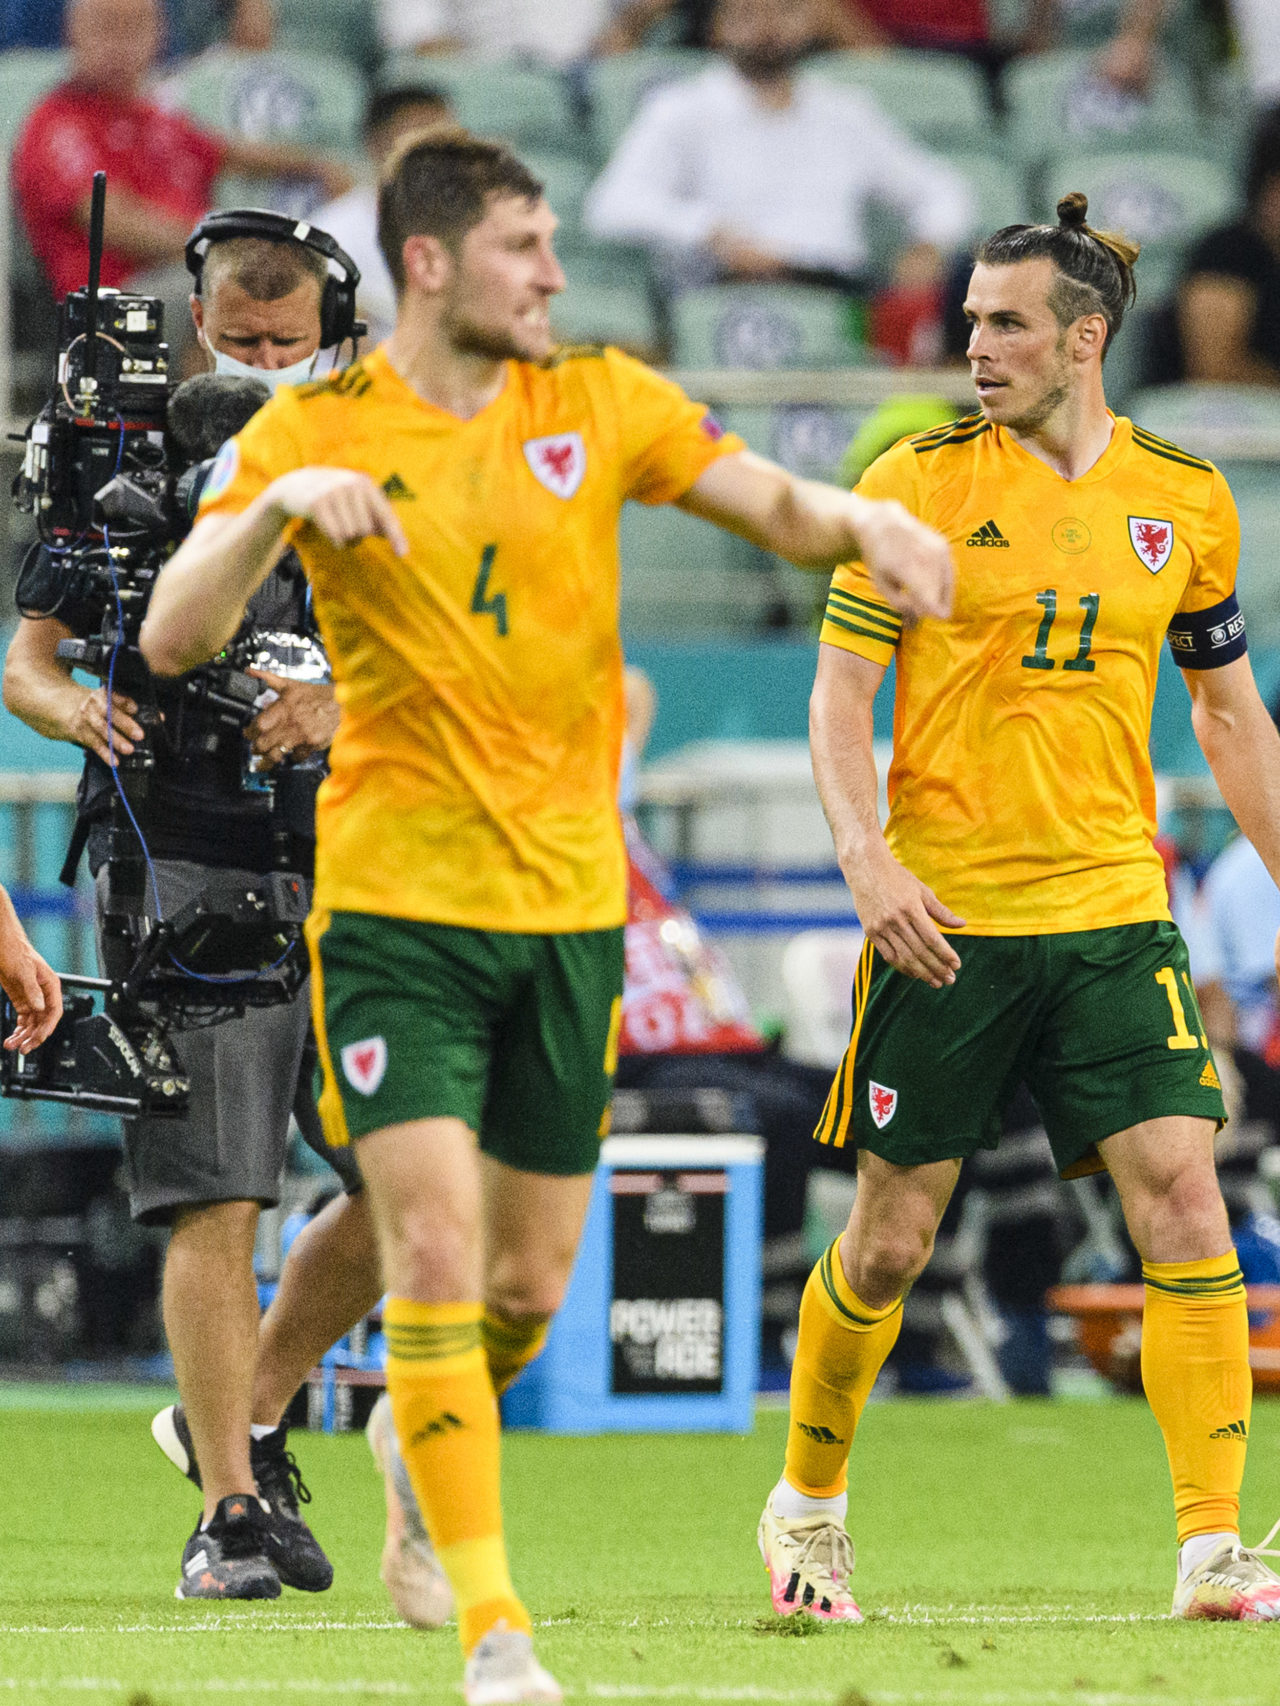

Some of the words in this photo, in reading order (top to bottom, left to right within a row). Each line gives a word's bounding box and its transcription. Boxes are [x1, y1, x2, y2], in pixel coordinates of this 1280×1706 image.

[966, 537, 1010, 548] adidas
[471, 544, 508, 636] 4
[1021, 588, 1100, 672] 11
[610, 1299, 721, 1343] POWER
